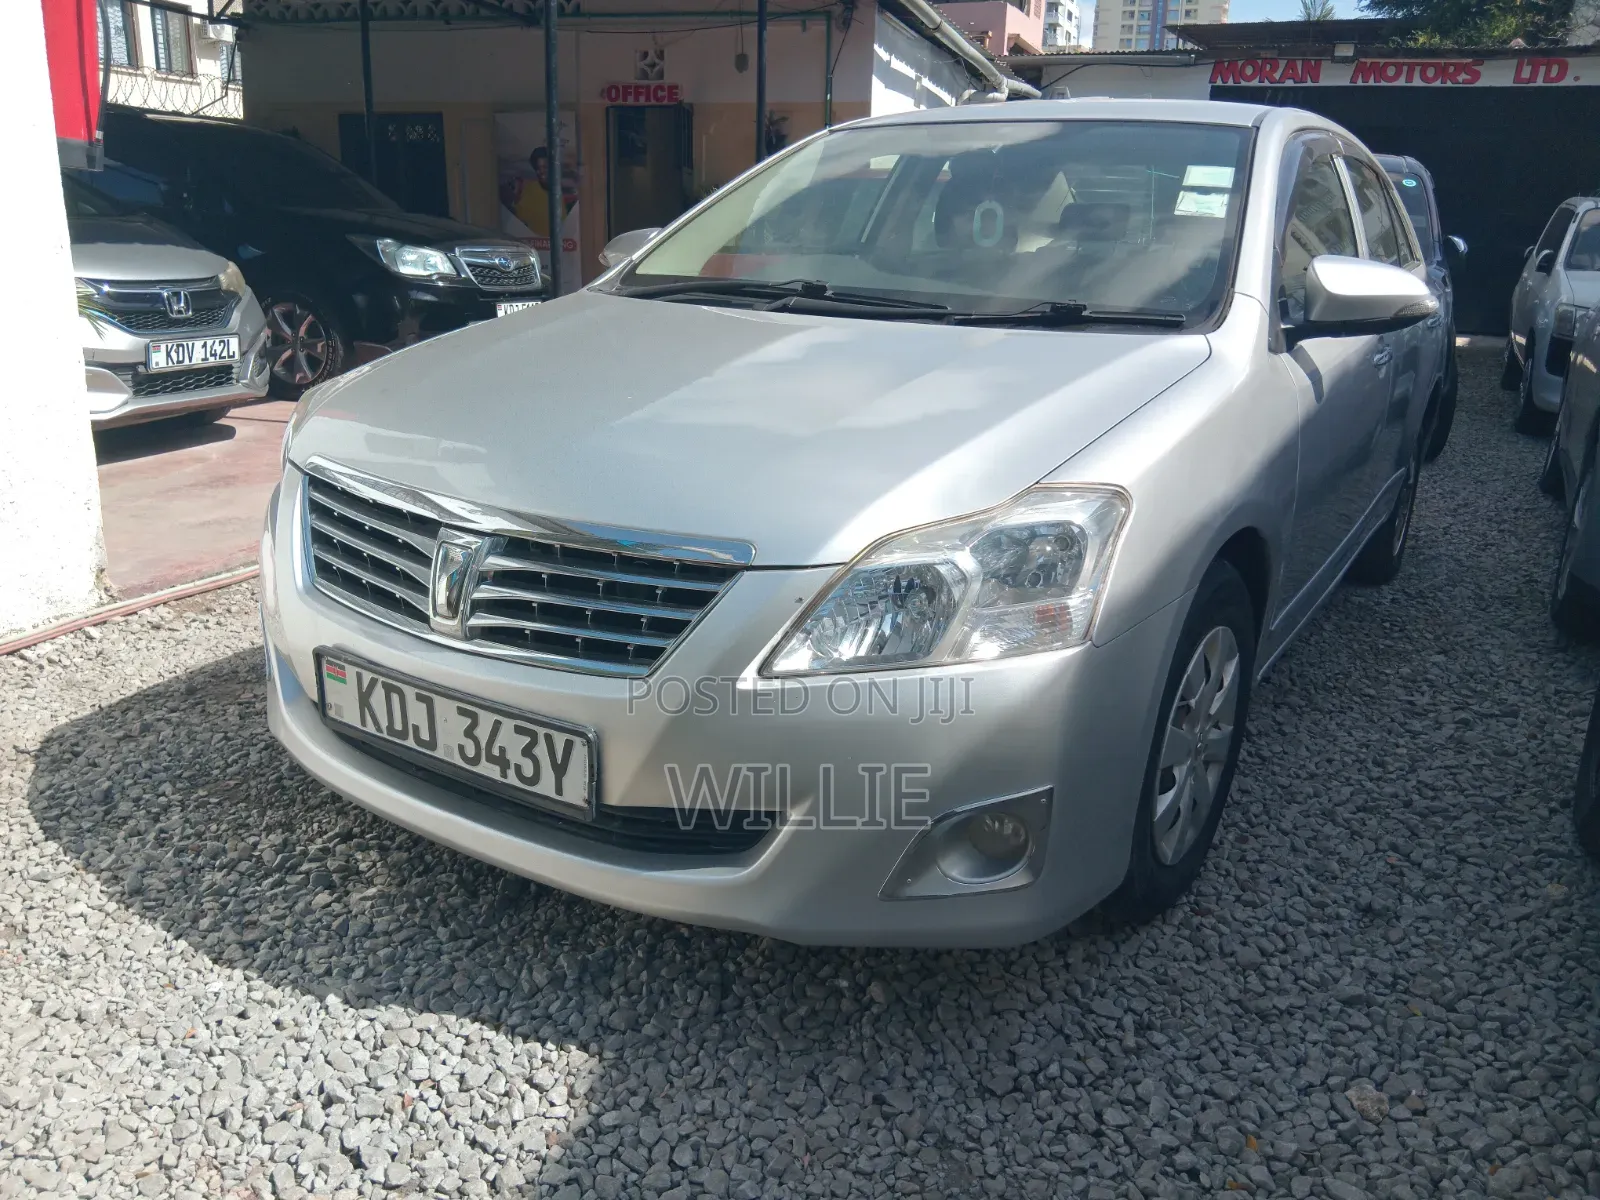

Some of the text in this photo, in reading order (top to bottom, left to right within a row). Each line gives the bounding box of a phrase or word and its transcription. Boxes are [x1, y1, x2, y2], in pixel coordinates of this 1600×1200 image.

[1209, 58, 1323, 84] MORAN
[1350, 59, 1485, 85] MOTORS
[606, 84, 680, 103] OFFICE
[165, 339, 236, 366] KDV 142L
[355, 670, 438, 752] KDJ
[456, 704, 575, 797] 343Y
